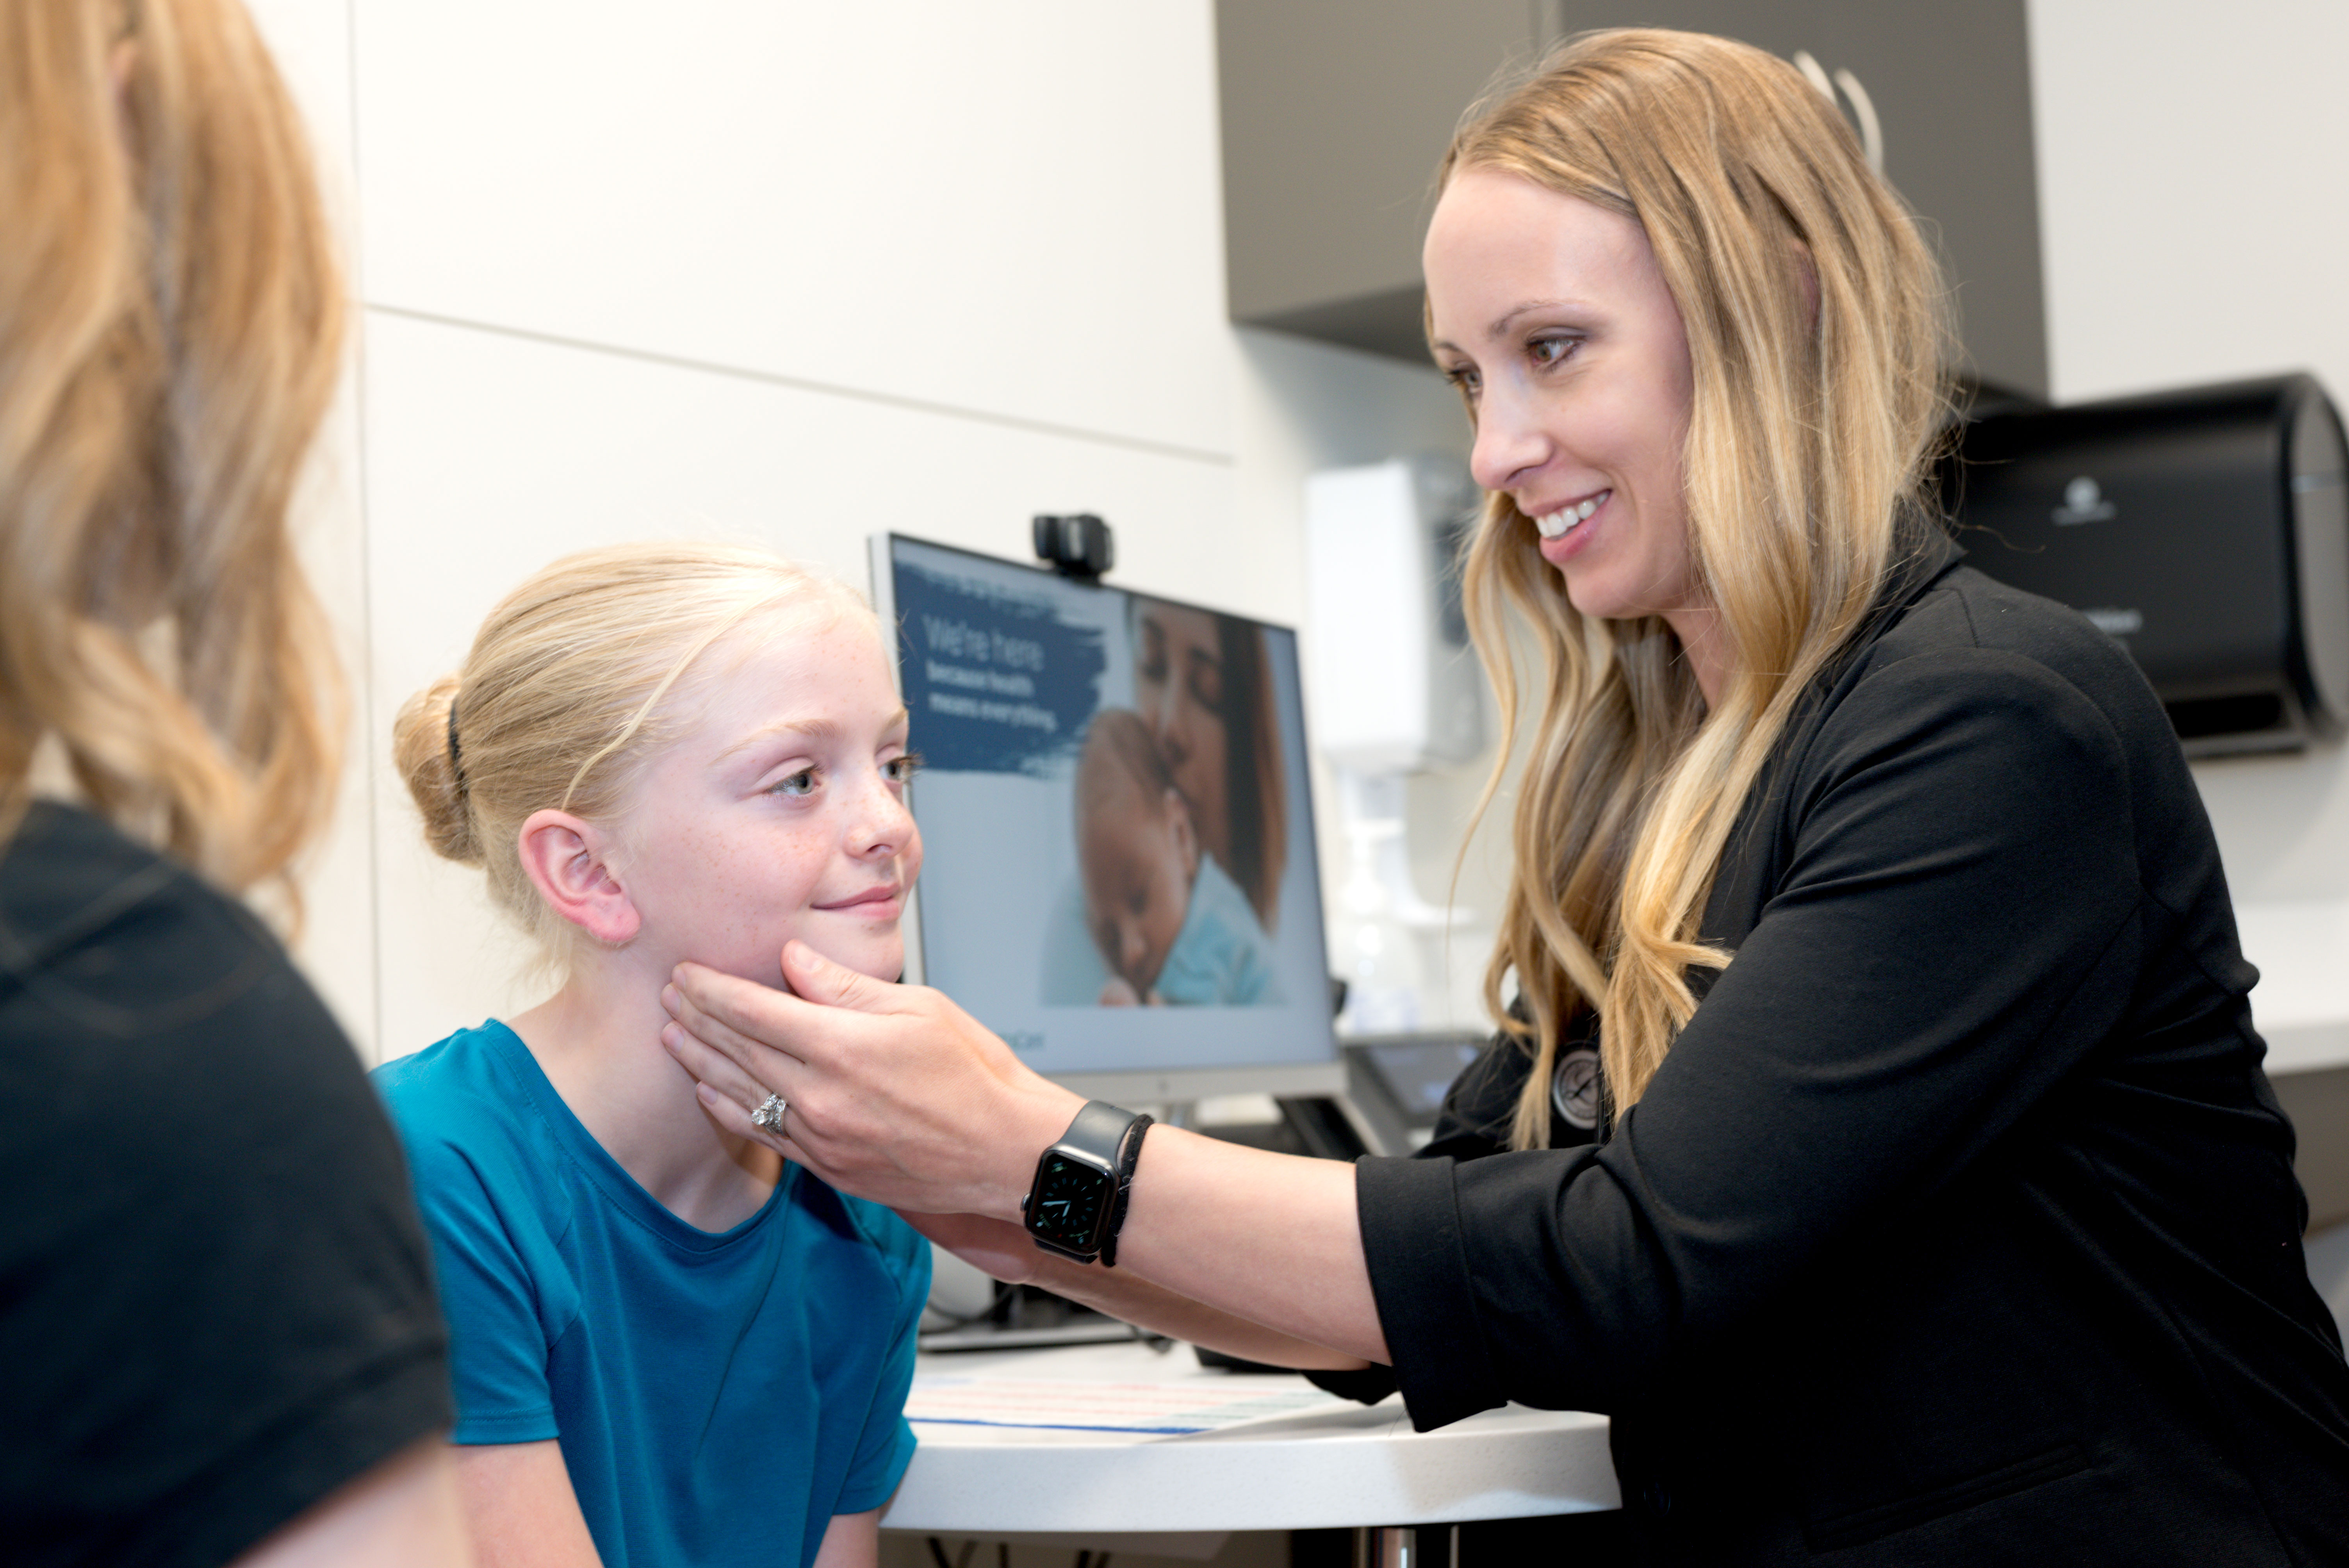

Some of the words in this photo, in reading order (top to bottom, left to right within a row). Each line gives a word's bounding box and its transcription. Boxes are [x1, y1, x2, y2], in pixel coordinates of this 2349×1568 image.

[923, 615, 990, 661] We're
[992, 628, 1044, 672] here
[926, 659, 986, 690] because
[989, 668, 1034, 697] health
[928, 692, 978, 718] means
